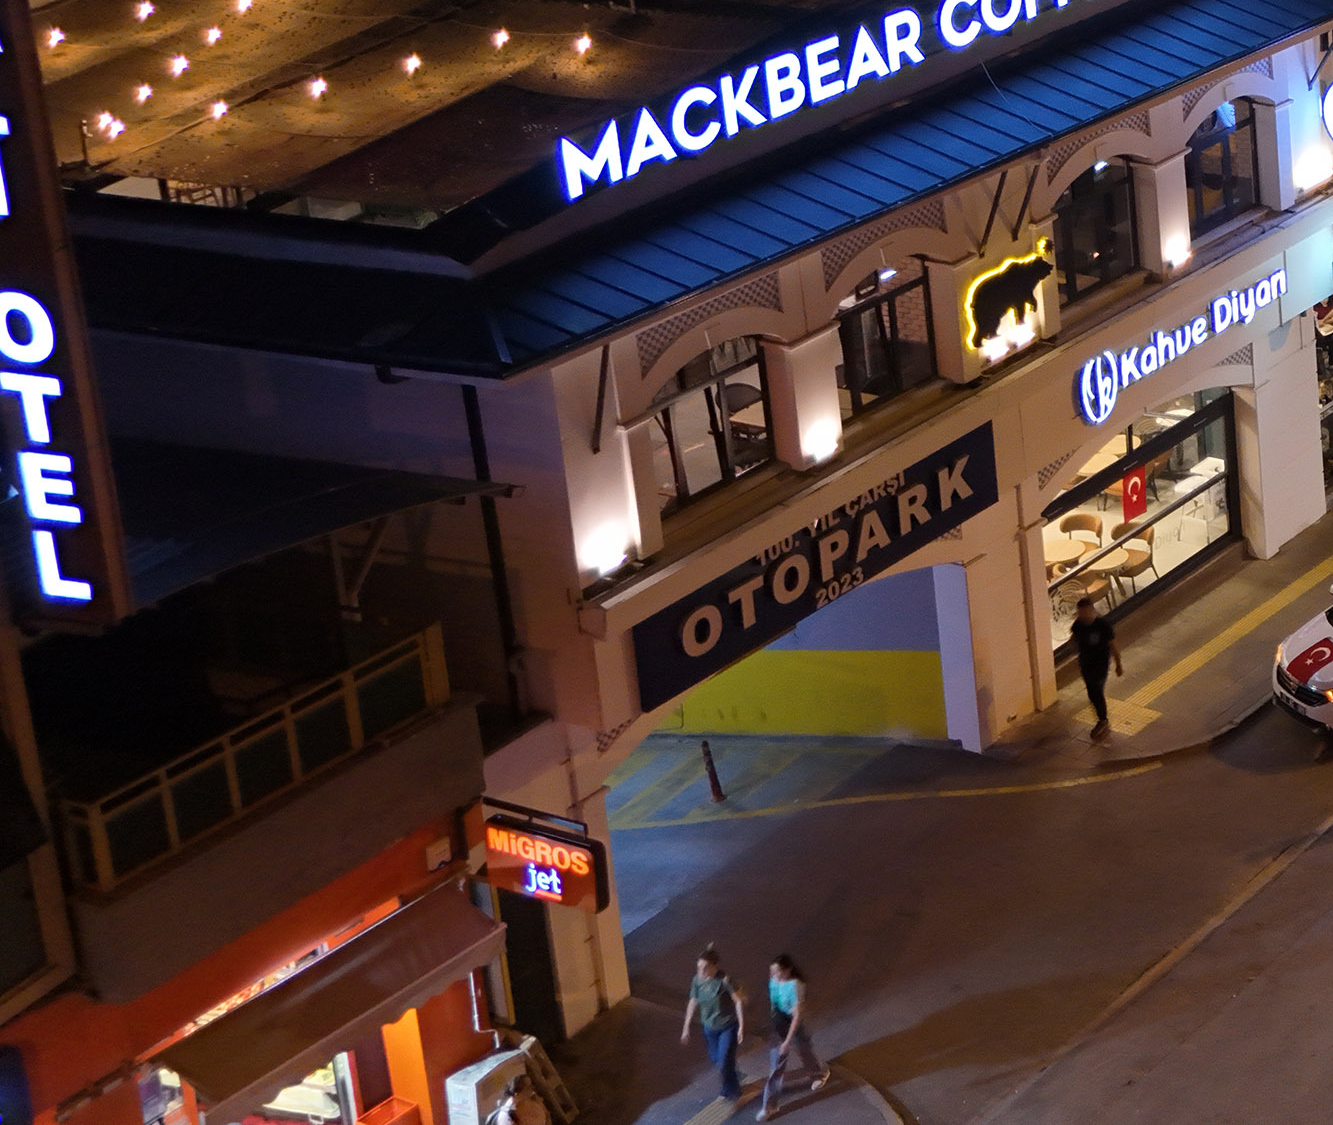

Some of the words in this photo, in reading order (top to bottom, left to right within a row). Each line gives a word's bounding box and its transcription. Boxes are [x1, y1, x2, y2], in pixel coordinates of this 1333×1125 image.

[556, 7, 926, 204] MACKBEAR
[1120, 315, 1208, 389] Kahve
[0, 288, 94, 603] OTEL
[681, 453, 975, 659] OTOPARK
[815, 564, 866, 611] 2023
[525, 862, 562, 894] jet
